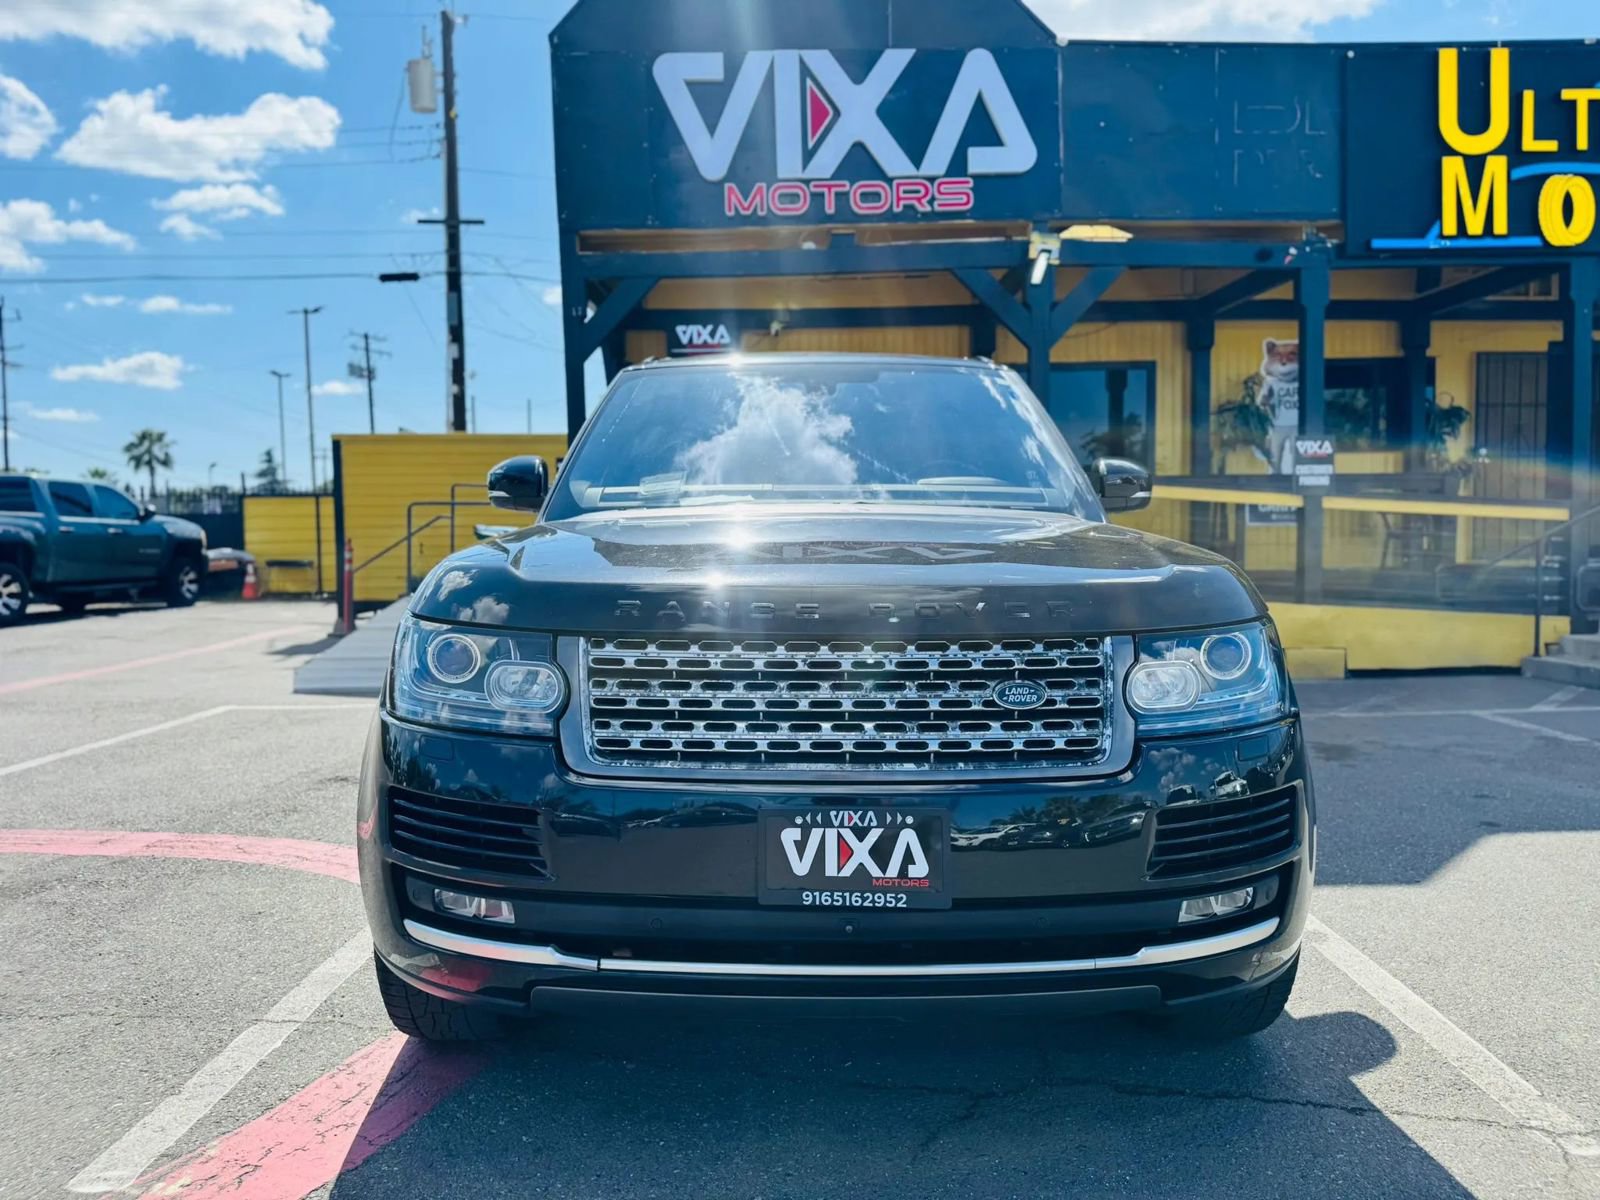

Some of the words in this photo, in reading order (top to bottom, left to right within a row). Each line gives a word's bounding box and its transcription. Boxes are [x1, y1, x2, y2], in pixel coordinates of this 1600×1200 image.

[652, 48, 1037, 181] VIXA
[724, 177, 975, 216] MOTORS
[674, 323, 732, 345] VIXA
[1295, 441, 1333, 454] VIXA
[868, 600, 1077, 622] ROVER
[1005, 687, 1030, 695] LAND
[1008, 694, 1038, 703] ROVER
[829, 810, 878, 827] VIXA
[780, 827, 930, 878] VIXA
[872, 878, 930, 888] MOTORS
[802, 891, 908, 908] 9165162952
